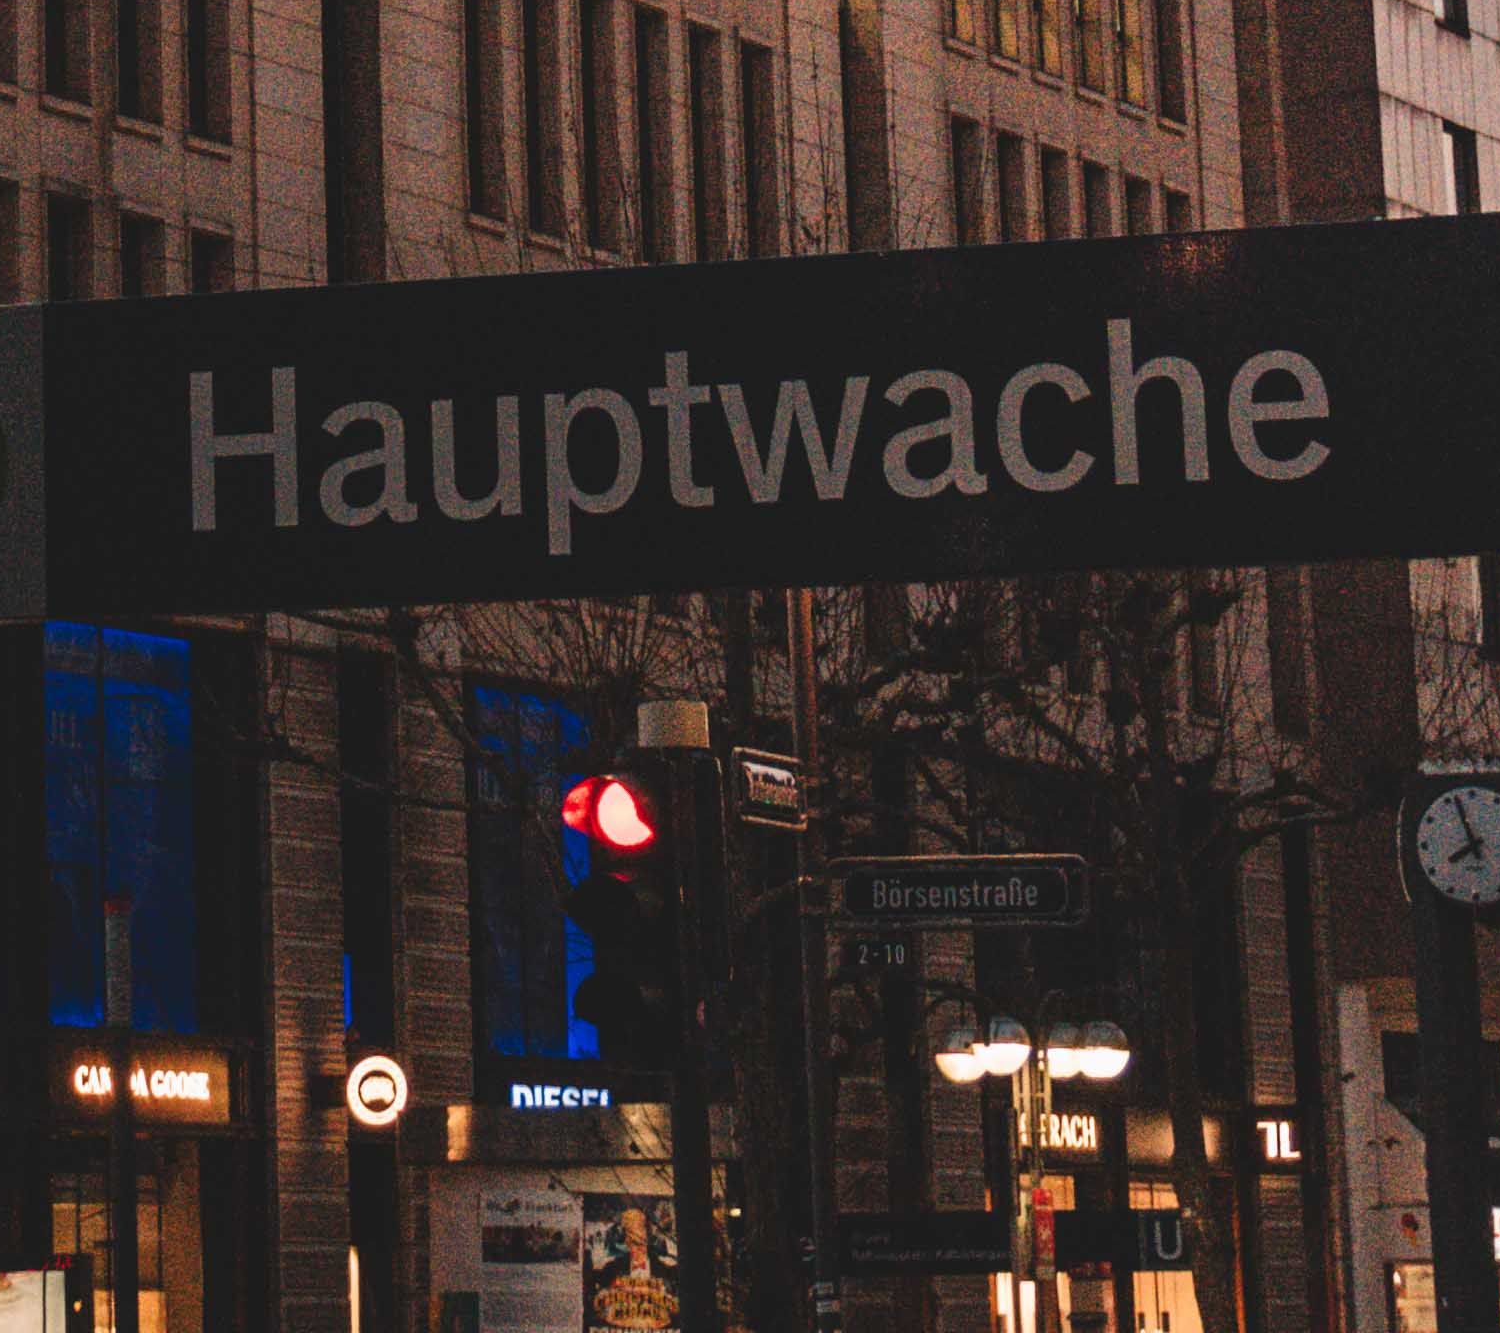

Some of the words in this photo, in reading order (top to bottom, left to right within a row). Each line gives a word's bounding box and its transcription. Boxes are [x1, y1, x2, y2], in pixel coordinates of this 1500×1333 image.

[190, 317, 1331, 555] Hauptwache
[872, 878, 1039, 910] Börsenstraße
[74, 1065, 149, 1097] CANA
[1154, 1219, 1183, 1261] U
